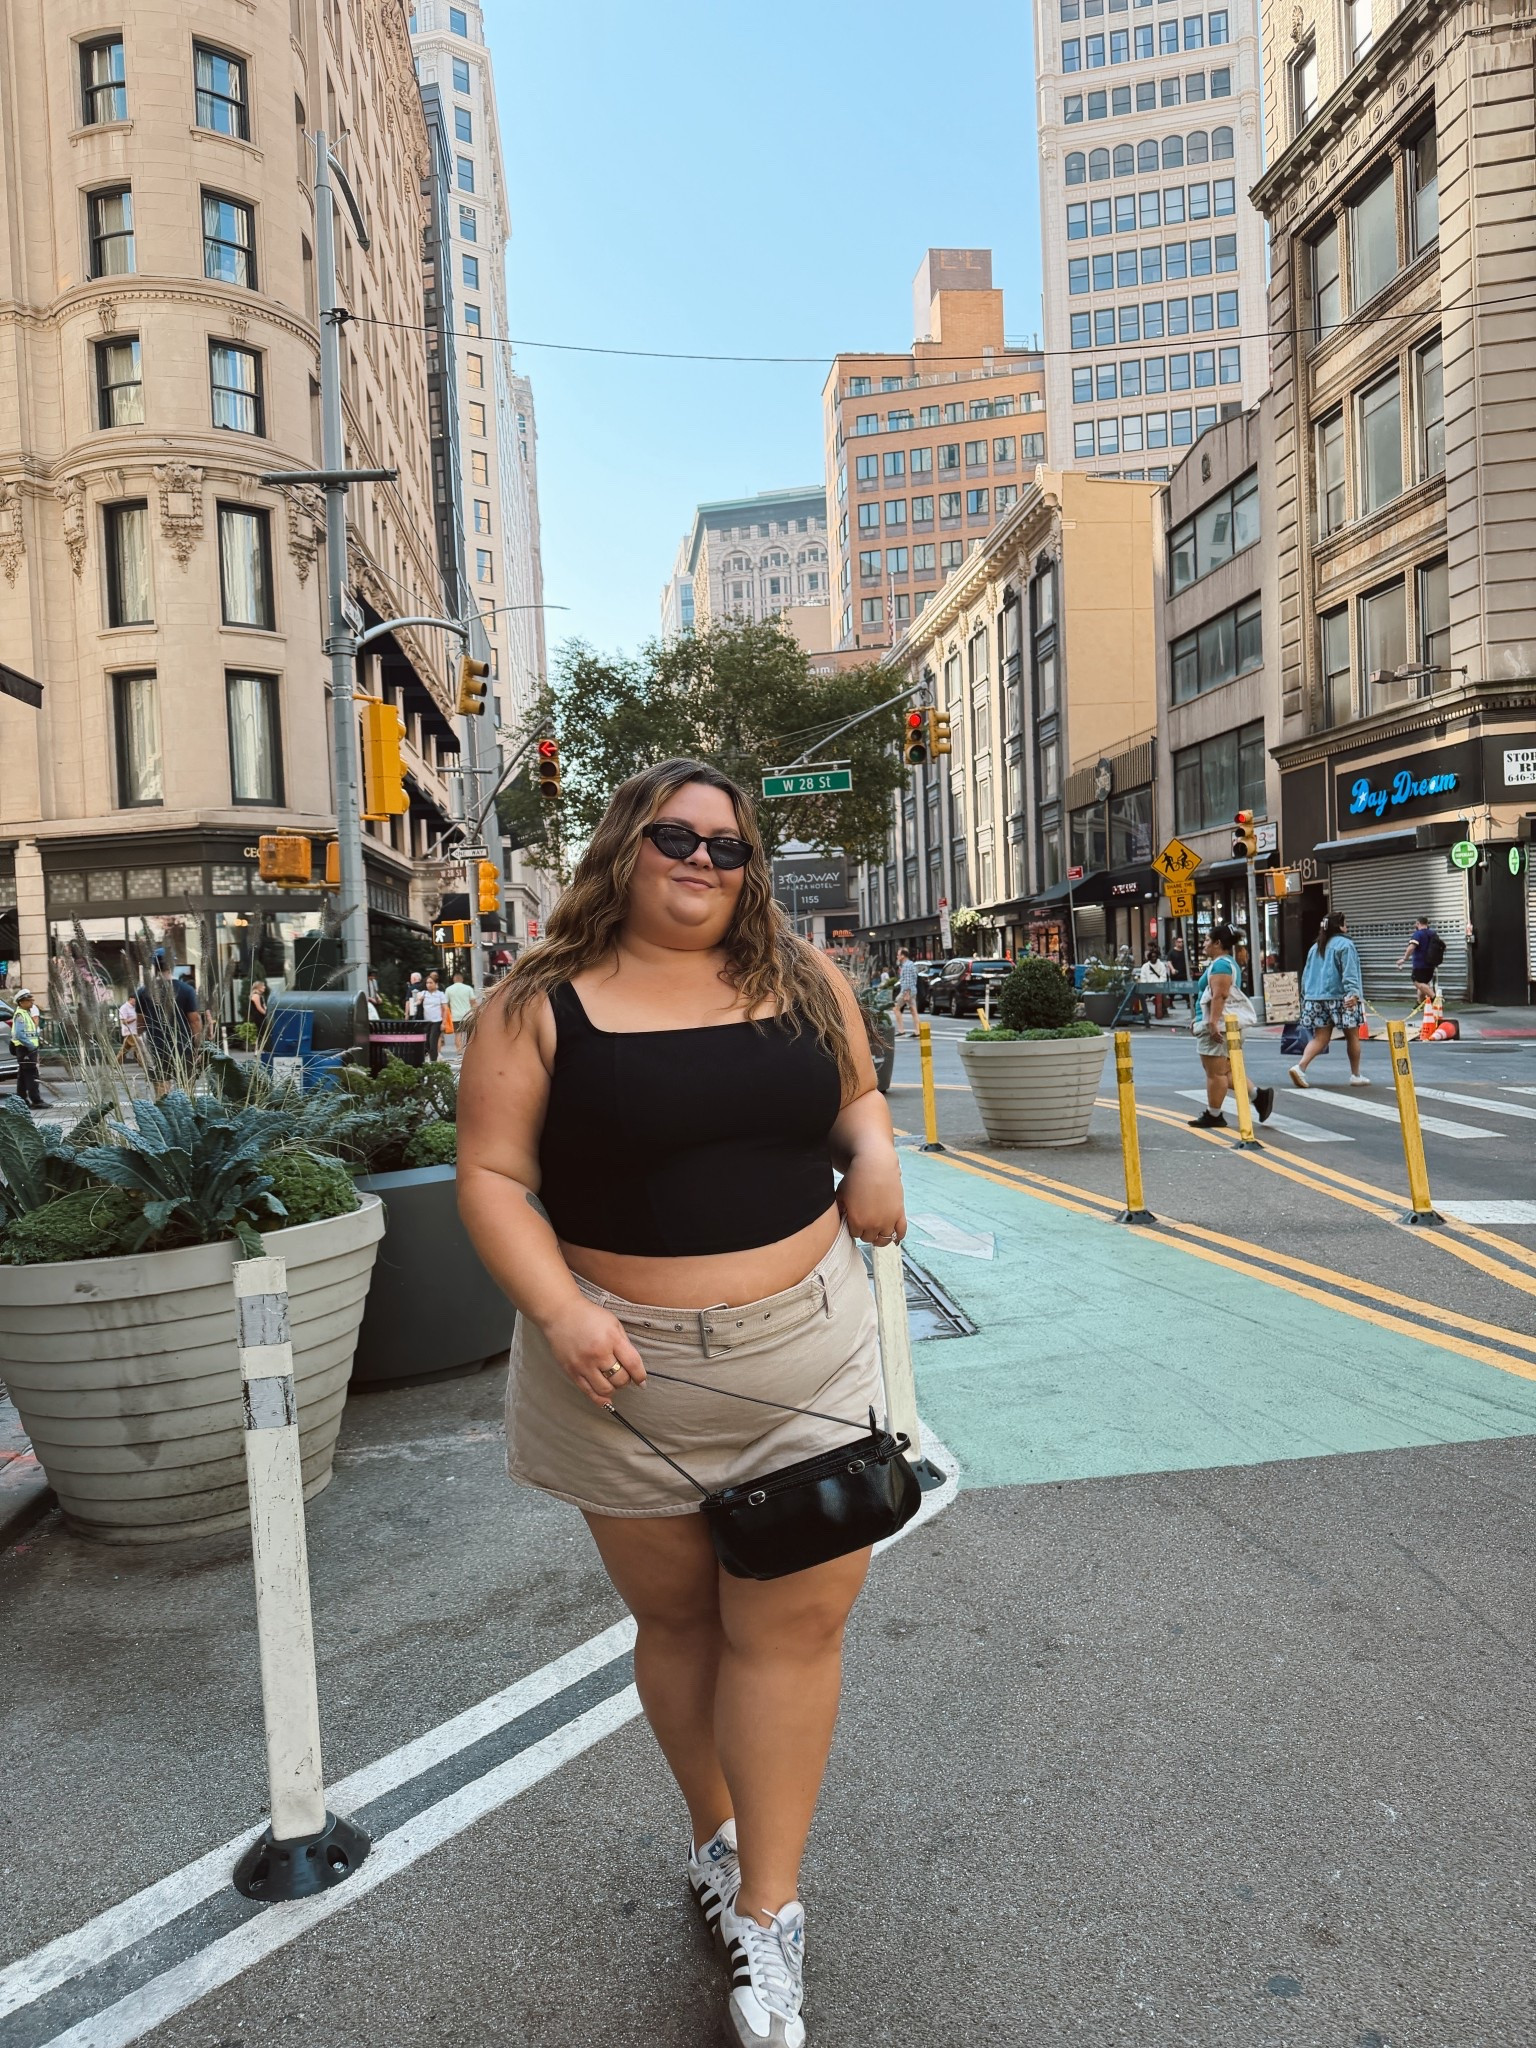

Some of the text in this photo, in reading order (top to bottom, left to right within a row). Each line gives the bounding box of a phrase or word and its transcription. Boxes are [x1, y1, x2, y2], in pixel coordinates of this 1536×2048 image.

[782, 775, 832, 792] W 28 St
[1349, 770, 1456, 817] Day Dream
[778, 871, 840, 885] BROADWAY
[810, 882, 834, 890] HOTEL
[801, 895, 820, 904] 1155
[1176, 896, 1186, 908] 5
